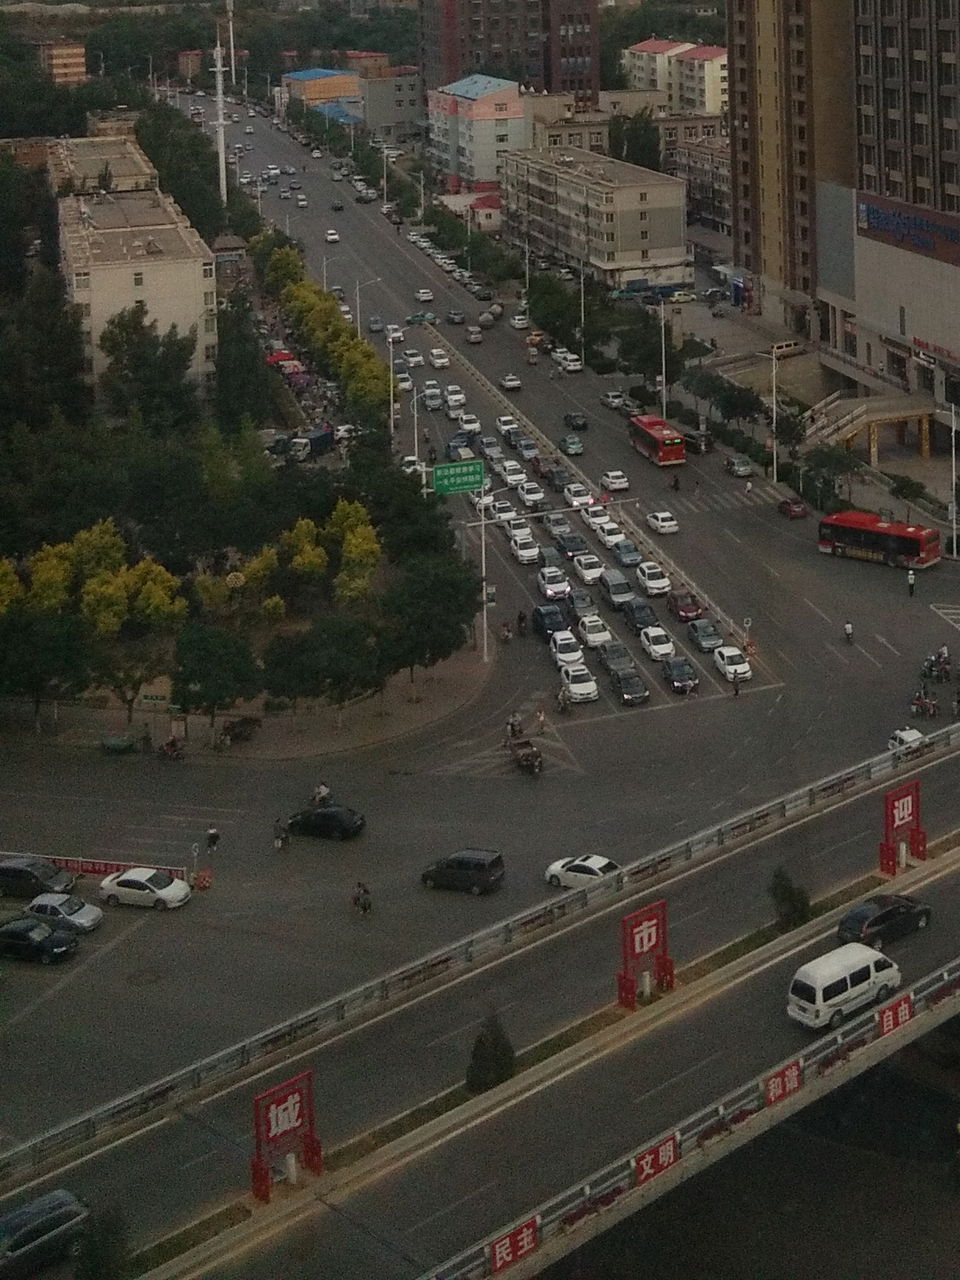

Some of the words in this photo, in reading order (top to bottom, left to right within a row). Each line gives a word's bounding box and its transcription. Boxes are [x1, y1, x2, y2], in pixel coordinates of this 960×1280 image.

[893, 795, 914, 829] 迎
[632, 919, 658, 955] 市
[881, 999, 911, 1033] 自由
[767, 1066, 801, 1101] 和谐
[268, 1090, 302, 1139] 城
[638, 1140, 675, 1179] 文明
[495, 1228, 536, 1270] 民主
